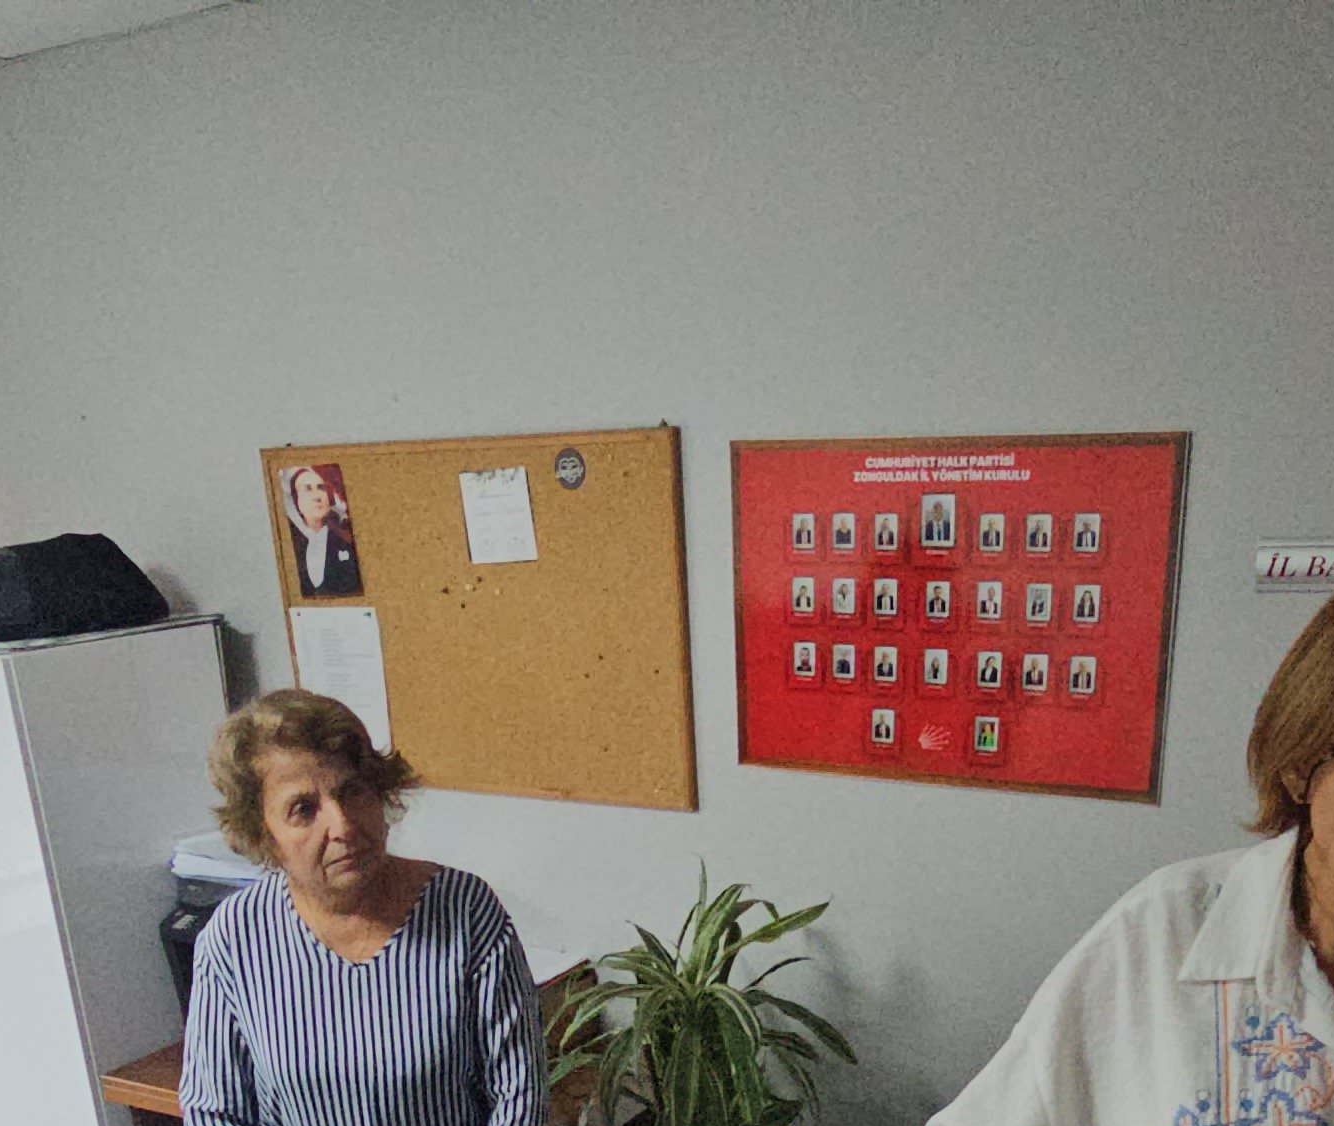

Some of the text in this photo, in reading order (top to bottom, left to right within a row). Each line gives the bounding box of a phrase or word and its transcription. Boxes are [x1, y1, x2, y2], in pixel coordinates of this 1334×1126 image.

[865, 452, 1015, 468] CUMHURİYET HALK PARTİSİ
[853, 471, 919, 482] ZONGULDAK
[984, 469, 1031, 481] KURULU
[1266, 553, 1297, 577] İL
